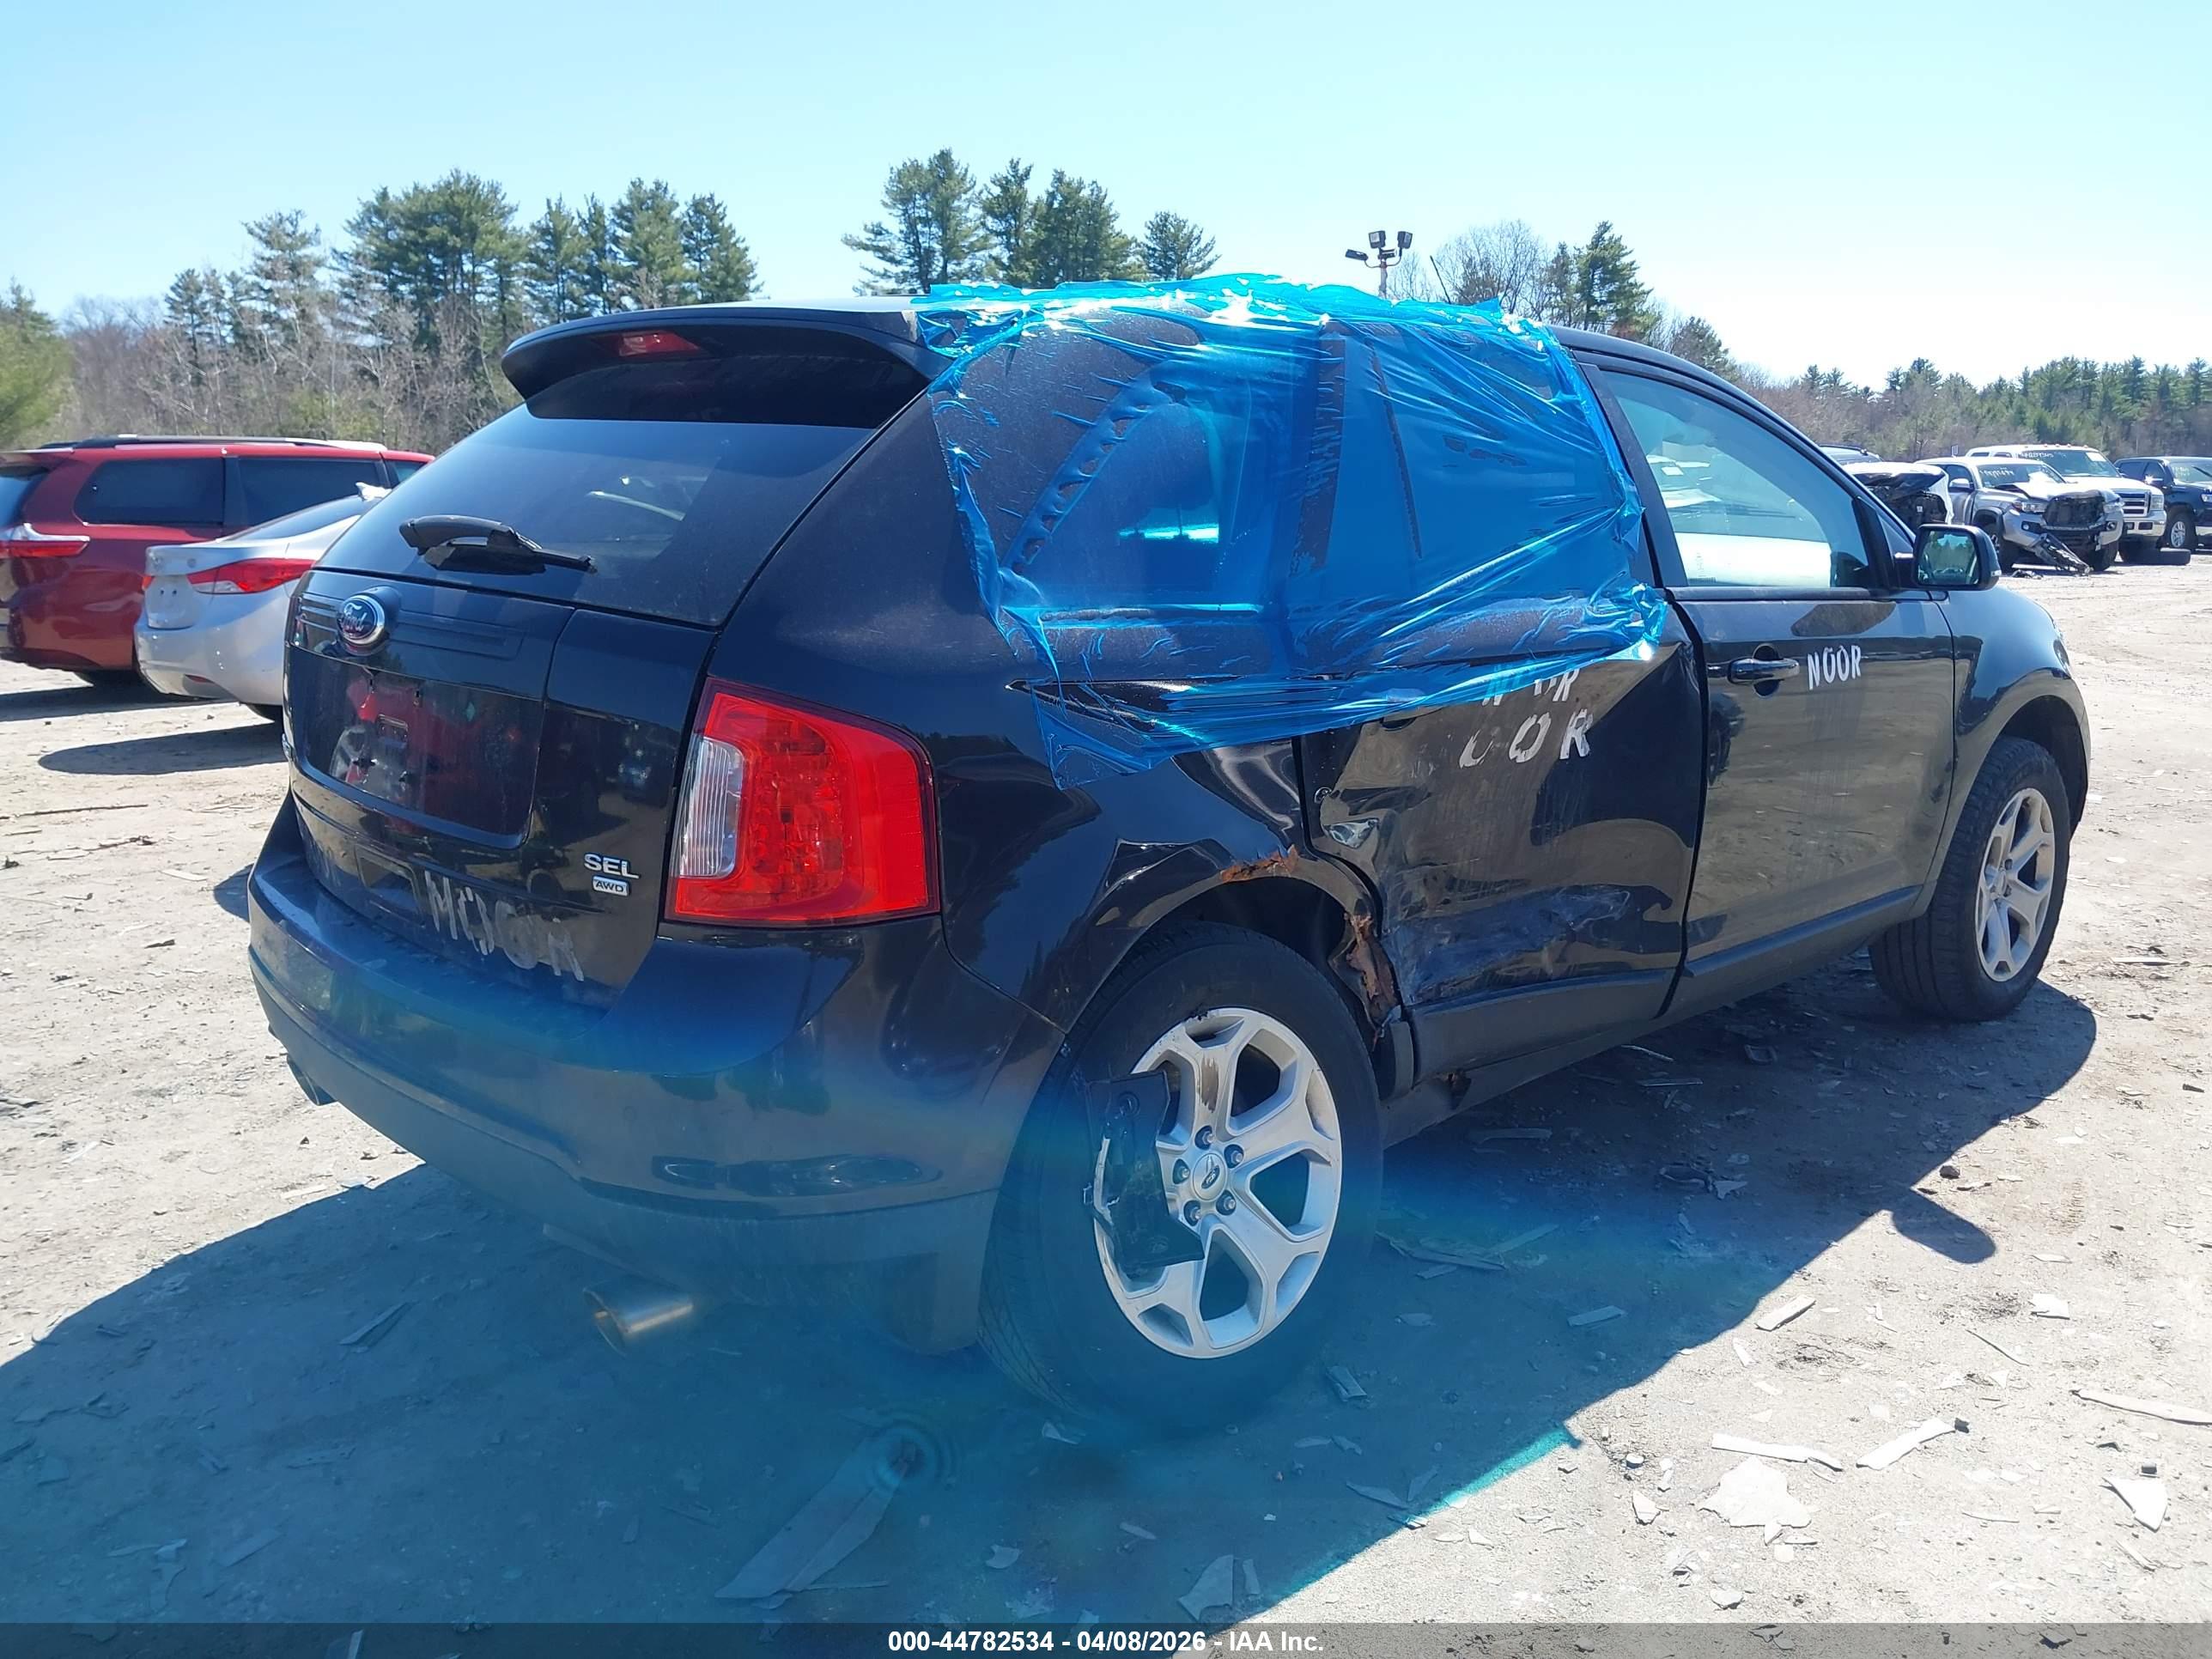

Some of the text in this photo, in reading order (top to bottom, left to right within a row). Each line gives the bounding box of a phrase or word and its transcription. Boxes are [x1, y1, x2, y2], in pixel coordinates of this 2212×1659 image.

[1808, 645, 1862, 690] NOOR
[584, 854, 640, 879] SEL
[595, 881, 624, 893] AWD
